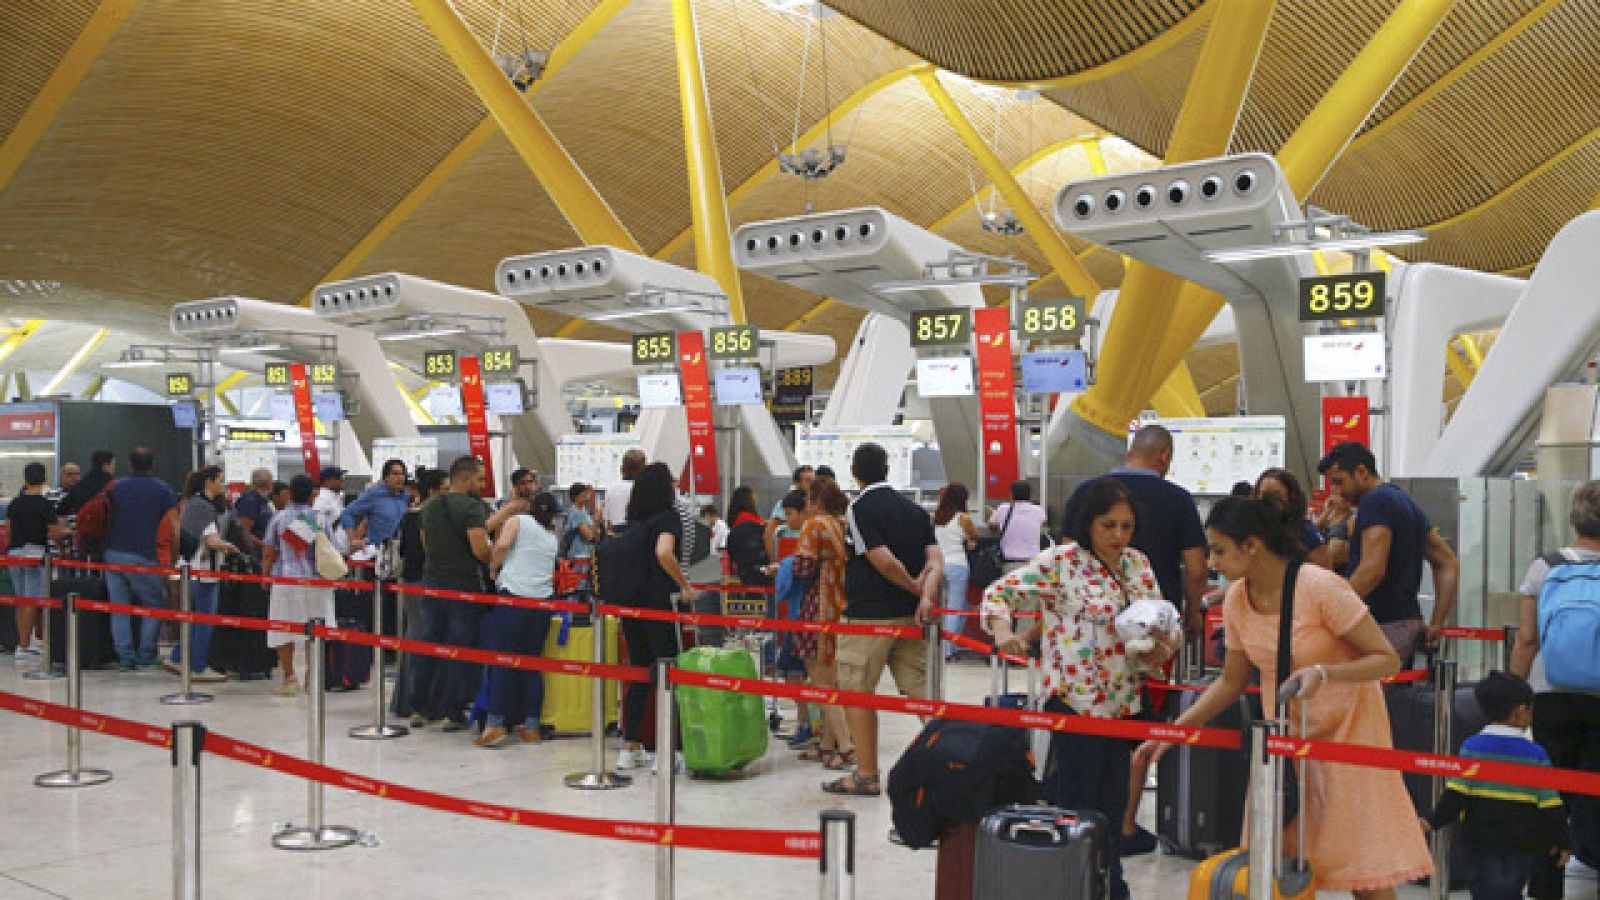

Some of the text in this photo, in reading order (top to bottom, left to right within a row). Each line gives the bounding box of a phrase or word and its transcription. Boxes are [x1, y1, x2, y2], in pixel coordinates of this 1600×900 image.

[1309, 280, 1374, 313] 859
[917, 314, 962, 341] 857
[1024, 304, 1076, 334] 858
[636, 336, 671, 359] 855
[714, 330, 751, 353] 856
[426, 354, 453, 375] 853
[484, 350, 512, 371] 854
[1413, 758, 1462, 771] IBERIA
